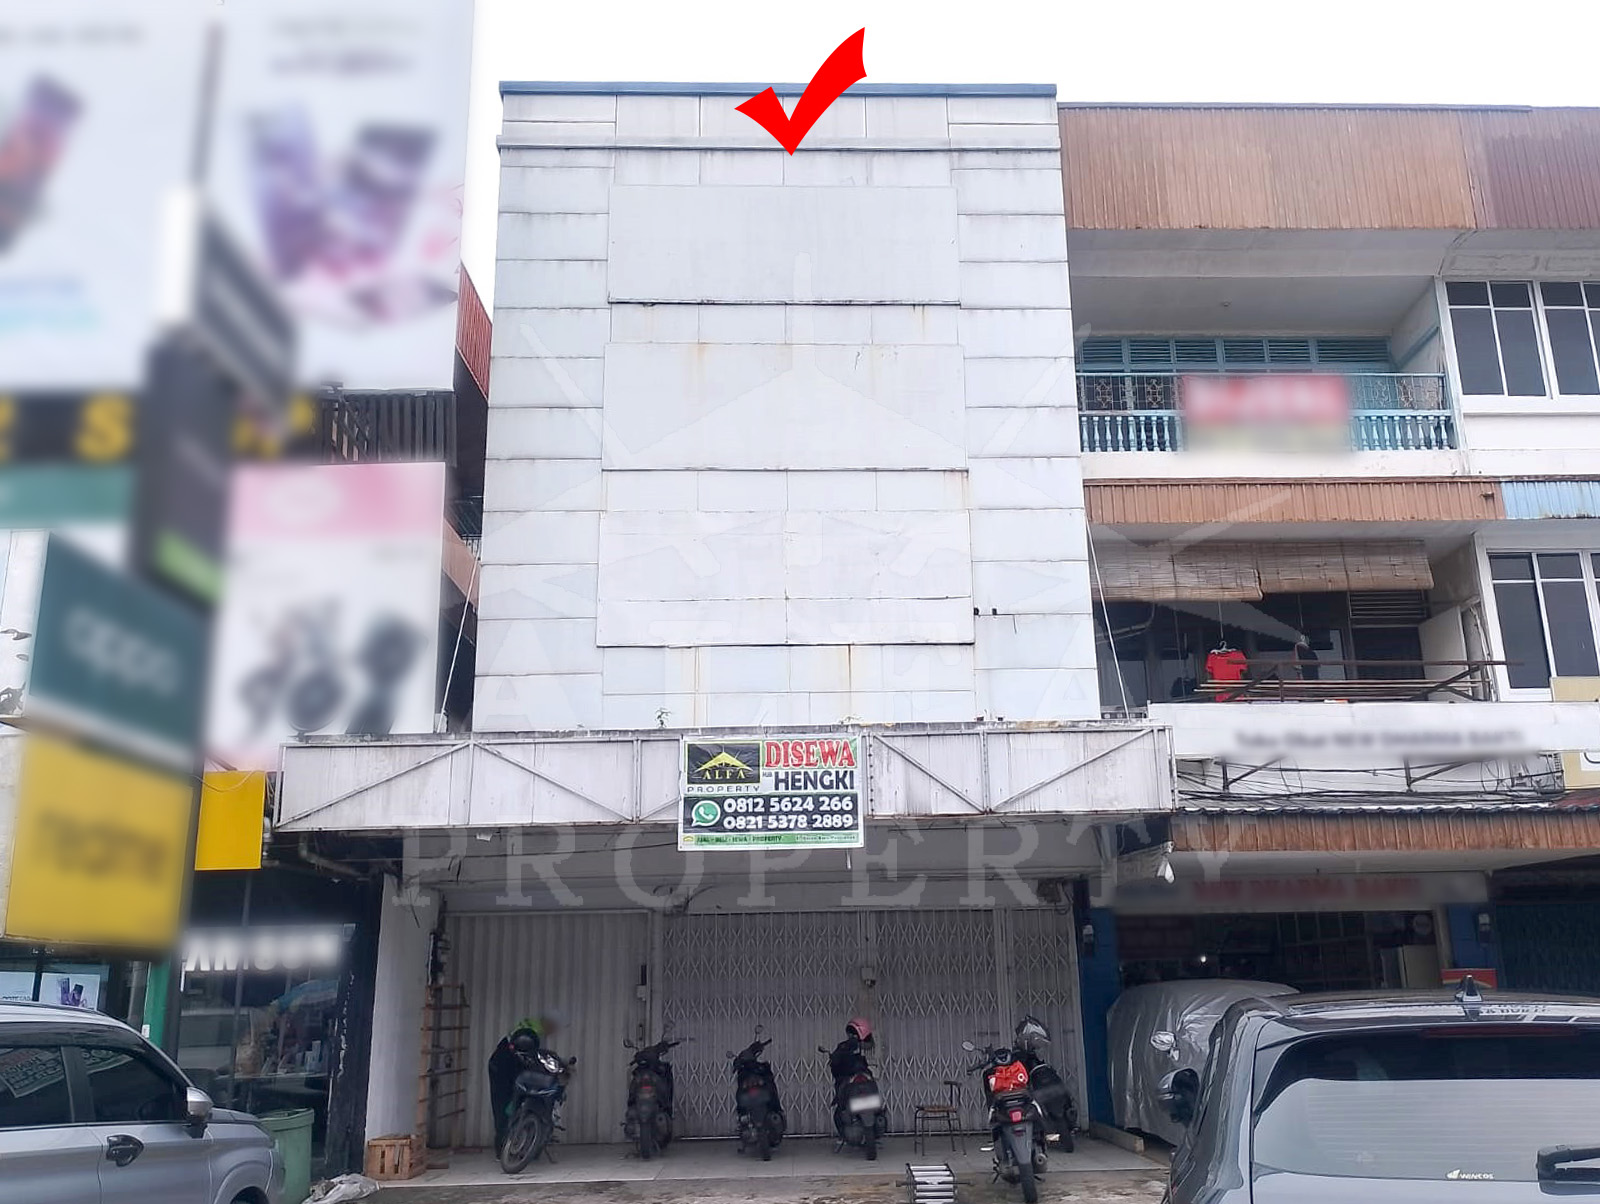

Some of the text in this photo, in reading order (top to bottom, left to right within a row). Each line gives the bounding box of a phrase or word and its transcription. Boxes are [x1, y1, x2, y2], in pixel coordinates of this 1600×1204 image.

[764, 740, 856, 768] DISEWA
[702, 768, 746, 780] ALFA
[774, 770, 854, 791] HENGKI
[687, 785, 760, 793] PROPERTY
[723, 796, 853, 813] 0812 5624 266
[723, 813, 854, 830] 0821 5378 2889
